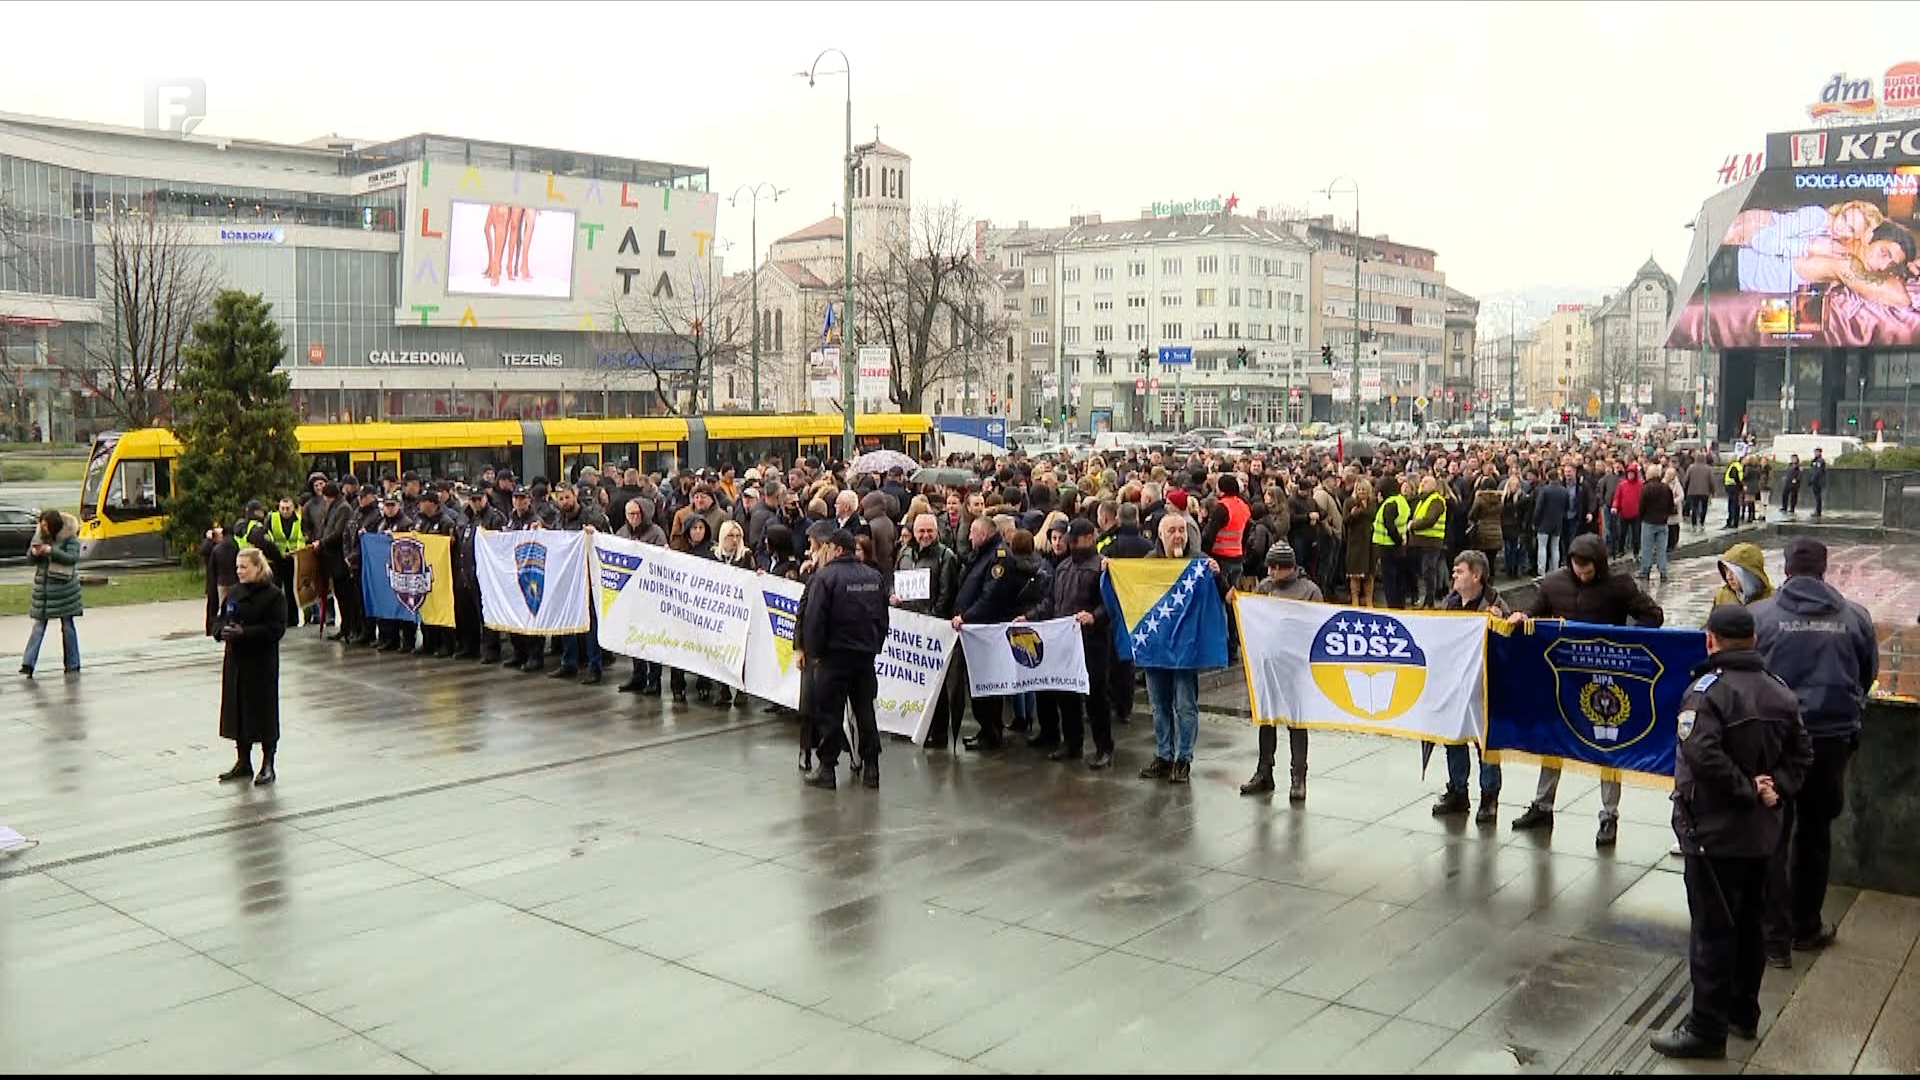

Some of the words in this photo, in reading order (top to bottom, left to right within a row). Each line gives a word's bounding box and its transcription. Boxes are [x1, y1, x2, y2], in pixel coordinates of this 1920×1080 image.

[1822, 75, 1870, 102] dm
[1151, 196, 1220, 217] Heineken
[369, 350, 465, 365] CALZEDONIA
[501, 352, 563, 366] TEZENIS
[649, 562, 689, 585] SINDIKAT
[690, 574, 731, 597] UPRAVE
[733, 585, 744, 601] ZA
[638, 578, 749, 621] INDIREKTNO-NEIZRAVNO
[660, 600, 725, 633] OPOREZIVANJE
[926, 637, 942, 652] ZA
[1325, 631, 1412, 658] SDSZ
[874, 662, 925, 685] ZIVANJE
[1592, 673, 1614, 686] SIPA
[975, 682, 1008, 691] SINDIKAT
